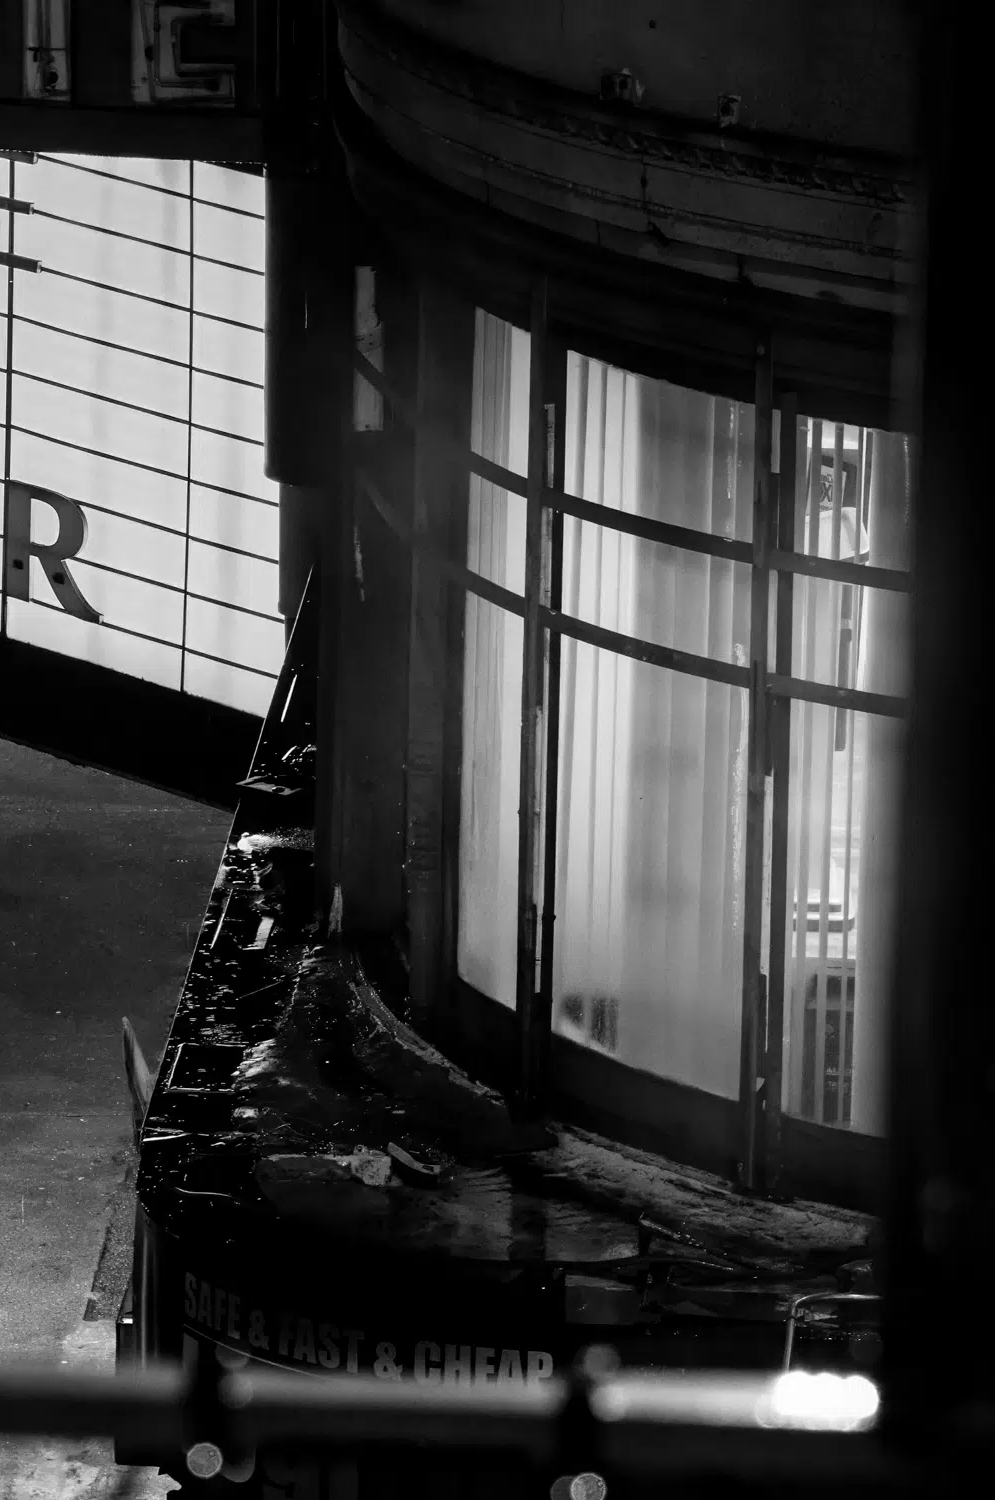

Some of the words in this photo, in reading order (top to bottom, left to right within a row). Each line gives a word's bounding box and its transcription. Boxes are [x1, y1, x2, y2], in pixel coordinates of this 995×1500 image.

[183, 1271, 243, 1341] SAFE
[248, 1308, 271, 1350] &
[277, 1311, 365, 1373] FAST
[373, 1341, 404, 1382] &
[413, 1339, 555, 1387] CHEAP
